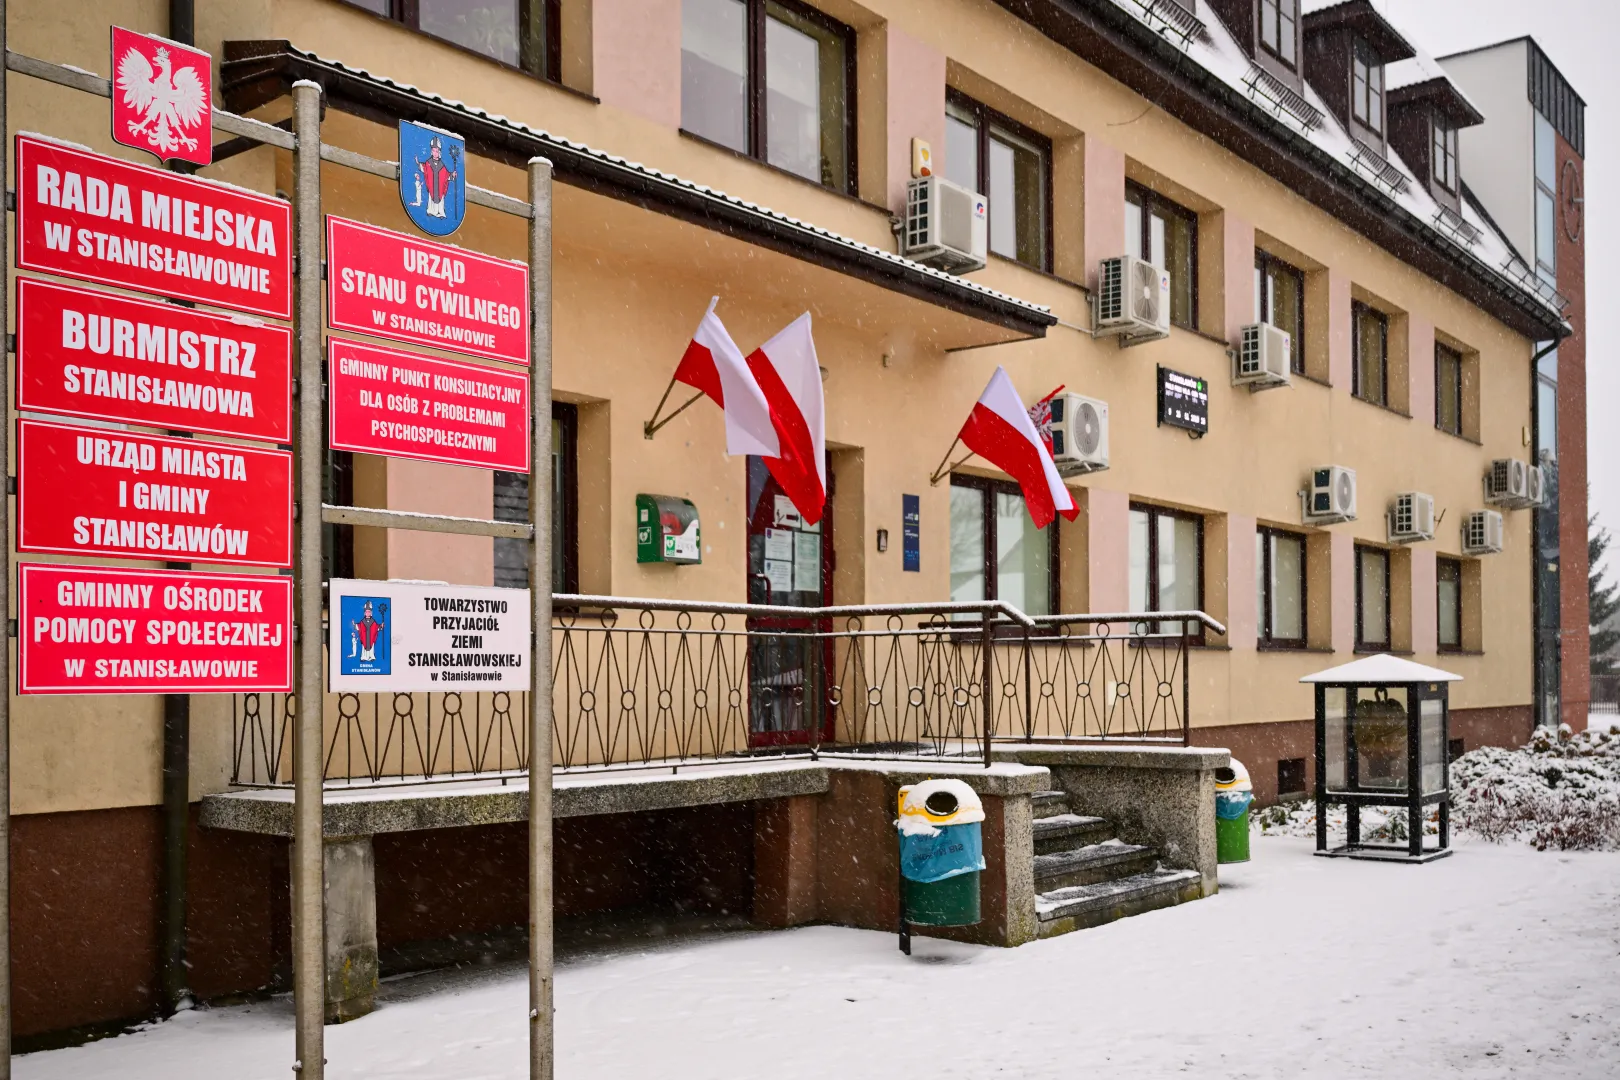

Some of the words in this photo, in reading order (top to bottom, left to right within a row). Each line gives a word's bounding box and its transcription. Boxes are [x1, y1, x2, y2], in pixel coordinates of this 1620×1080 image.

[38, 165, 134, 223] RADA
[142, 190, 277, 257] MIEJSKA
[44, 221, 72, 253] W
[78, 229, 270, 295] STANISŁAWOWIE
[404, 247, 466, 287] URZĄD
[341, 268, 407, 305] STANU
[416, 285, 521, 330] CYWILNEGO
[62, 310, 257, 379] BURMISTRZ
[372, 310, 388, 326] W
[390, 314, 496, 349] STANISŁAWOWIE
[64, 365, 254, 418] STANISŁAWOWA
[340, 357, 389, 383] GMINNY
[392, 367, 431, 389] PUNKT
[434, 374, 522, 406] KONSULTACYJNY
[360, 390, 383, 409] DLA
[387, 392, 419, 416] OSÓB
[422, 399, 430, 416] Z
[434, 402, 506, 428] PROBLEMAMI
[371, 420, 497, 453] PSYCHOSPOŁECZNYMI
[77, 436, 156, 474] URZĄD
[163, 447, 247, 482] MIASTA
[119, 481, 127, 508] I
[134, 482, 210, 515] GMINY
[74, 516, 249, 556] STANISŁAWÓW
[58, 581, 154, 609] GMINNY
[164, 582, 263, 613] OŚRODEK
[424, 597, 508, 614] TOWARZYSTWO
[34, 617, 137, 644] POMOCY
[147, 620, 282, 647] SPOŁECZNEJ
[433, 615, 500, 632] PRZYJACIÓŁ
[452, 635, 483, 649] ZIEMI
[64, 659, 86, 678] W
[95, 659, 258, 678] STANISŁAWOWIE
[408, 653, 522, 668] STANISŁAWOWSKIEJ
[431, 673, 438, 682] w
[442, 670, 502, 682] Stanisławowie
